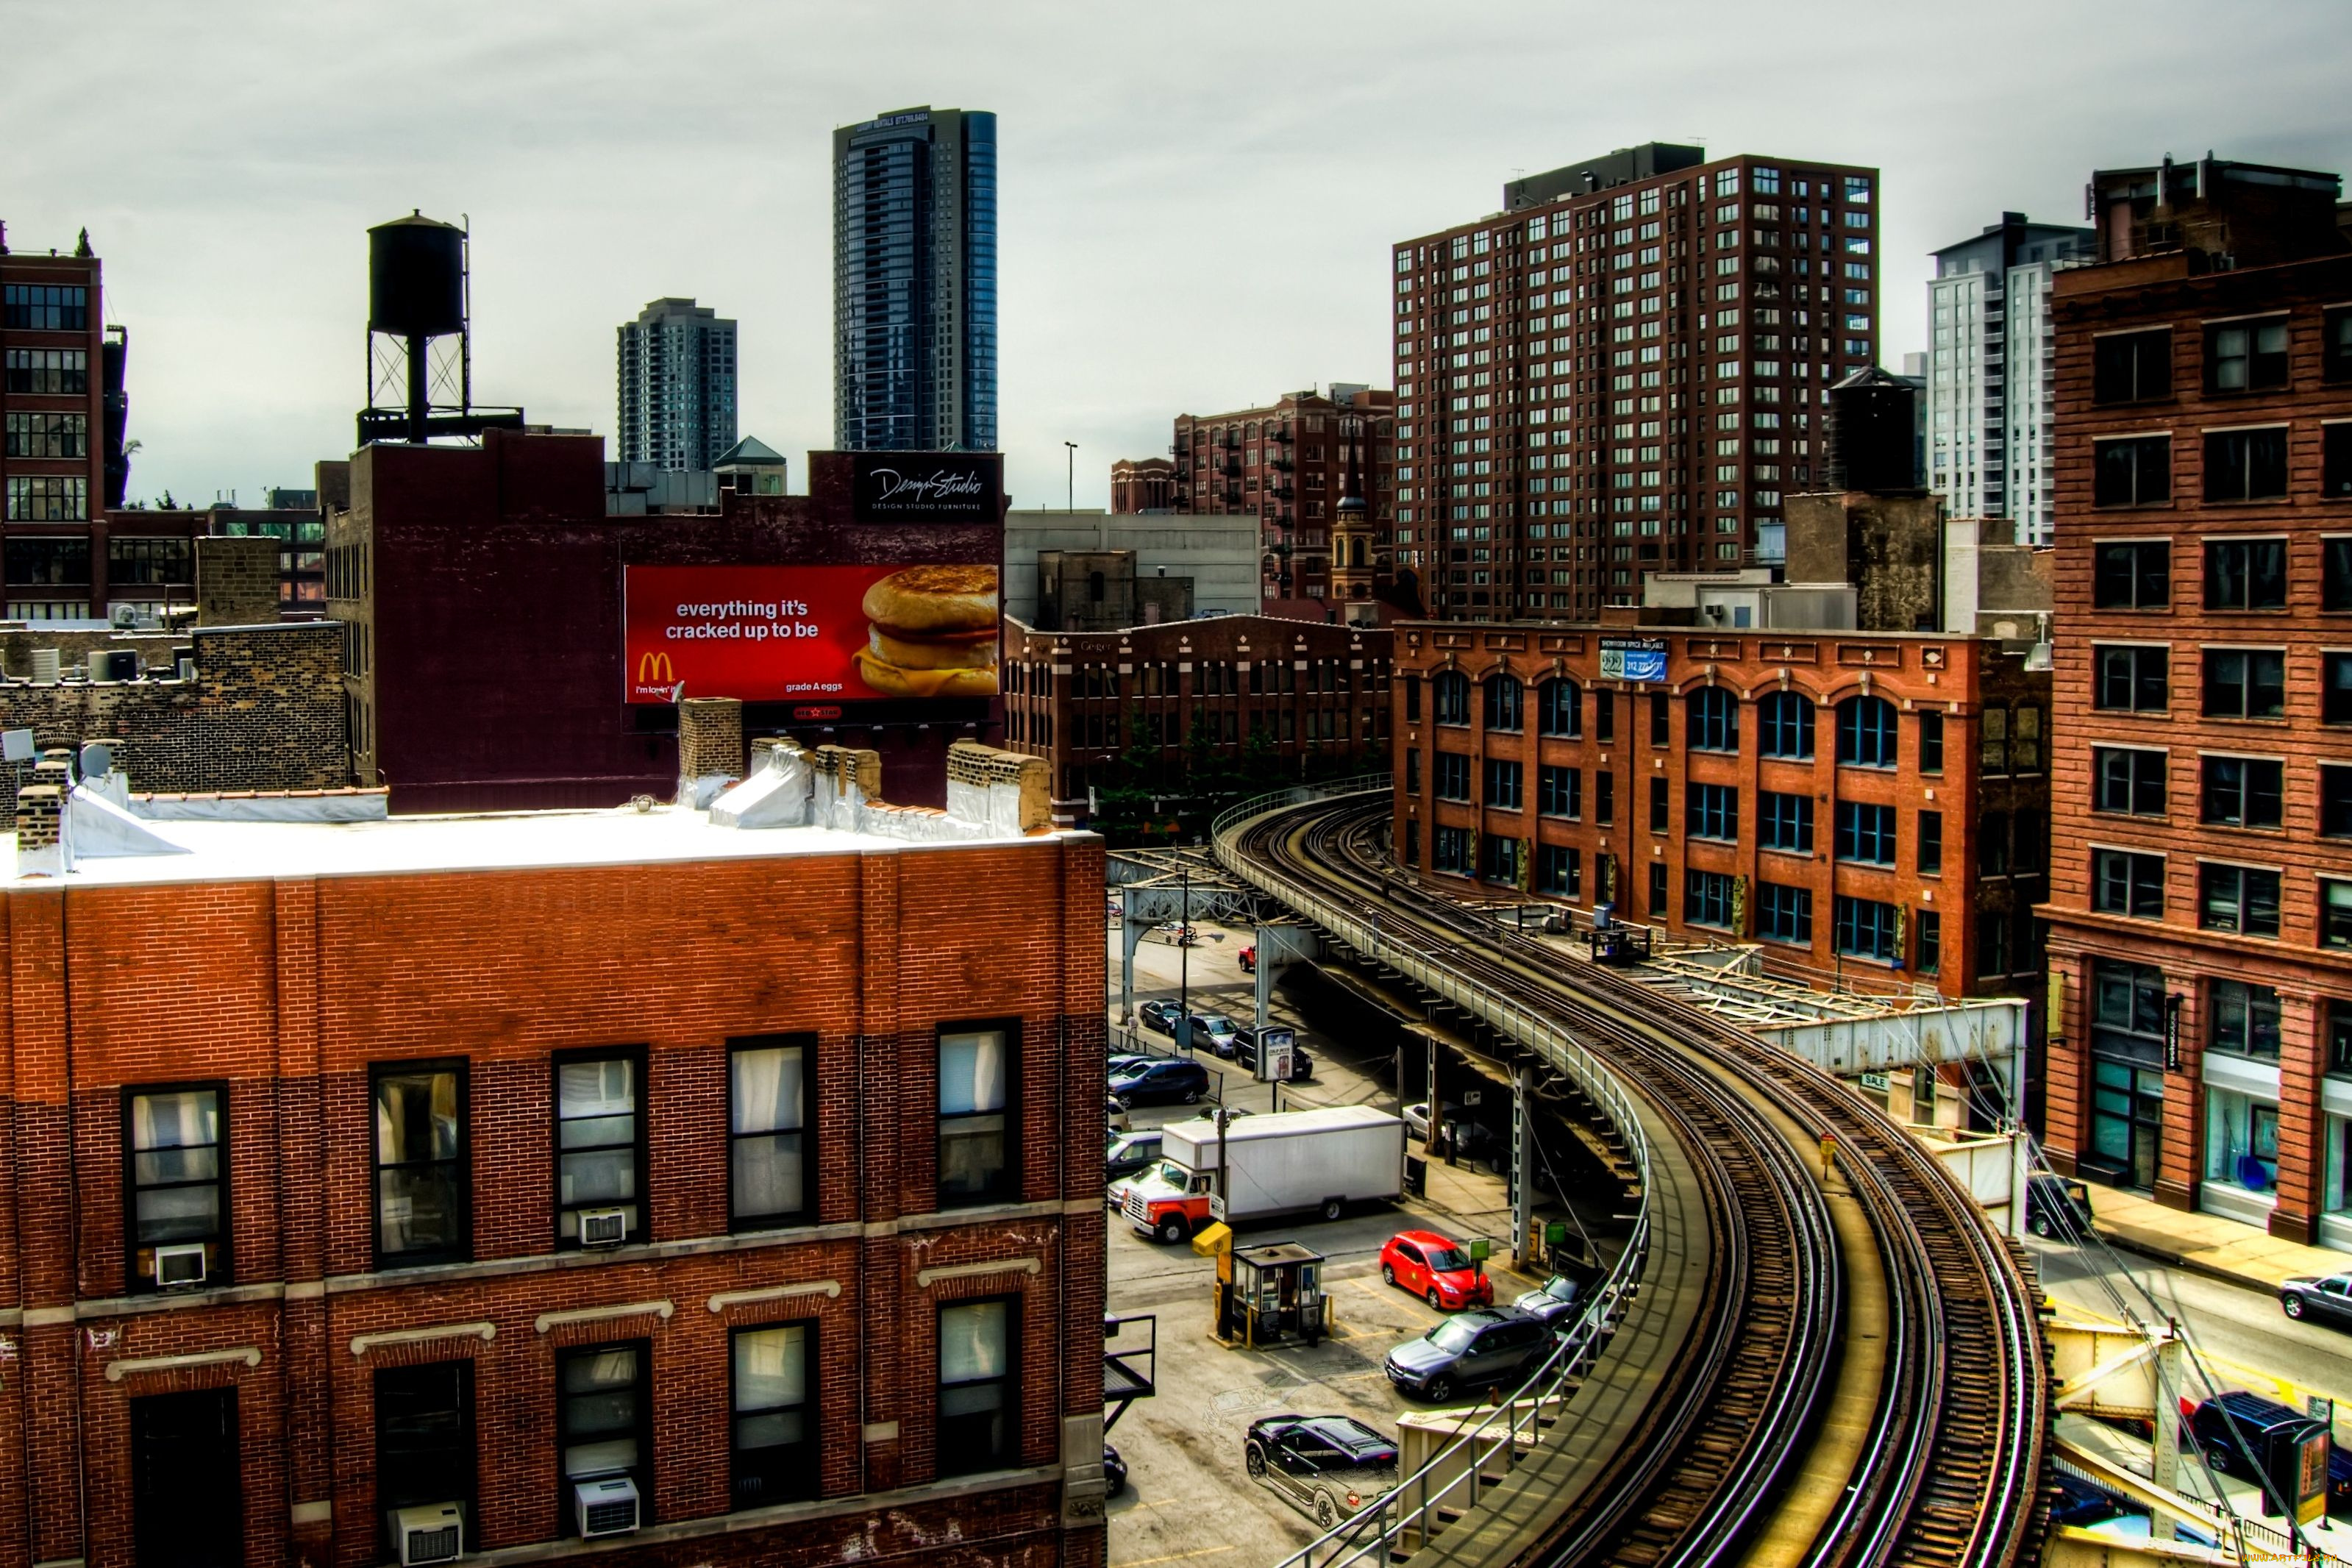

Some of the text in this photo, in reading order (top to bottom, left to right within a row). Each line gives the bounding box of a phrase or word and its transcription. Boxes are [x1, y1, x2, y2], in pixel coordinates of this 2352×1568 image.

[677, 600, 777, 620] everything
[666, 621, 819, 641] cracked up to be
[1080, 641, 1111, 653] Geiger
[1602, 655, 1622, 673] 222
[1626, 661, 1637, 671] 312
[635, 685, 648, 694] i'm
[786, 682, 843, 693] grade A eggs
[1866, 1075, 1886, 1088] SALE
